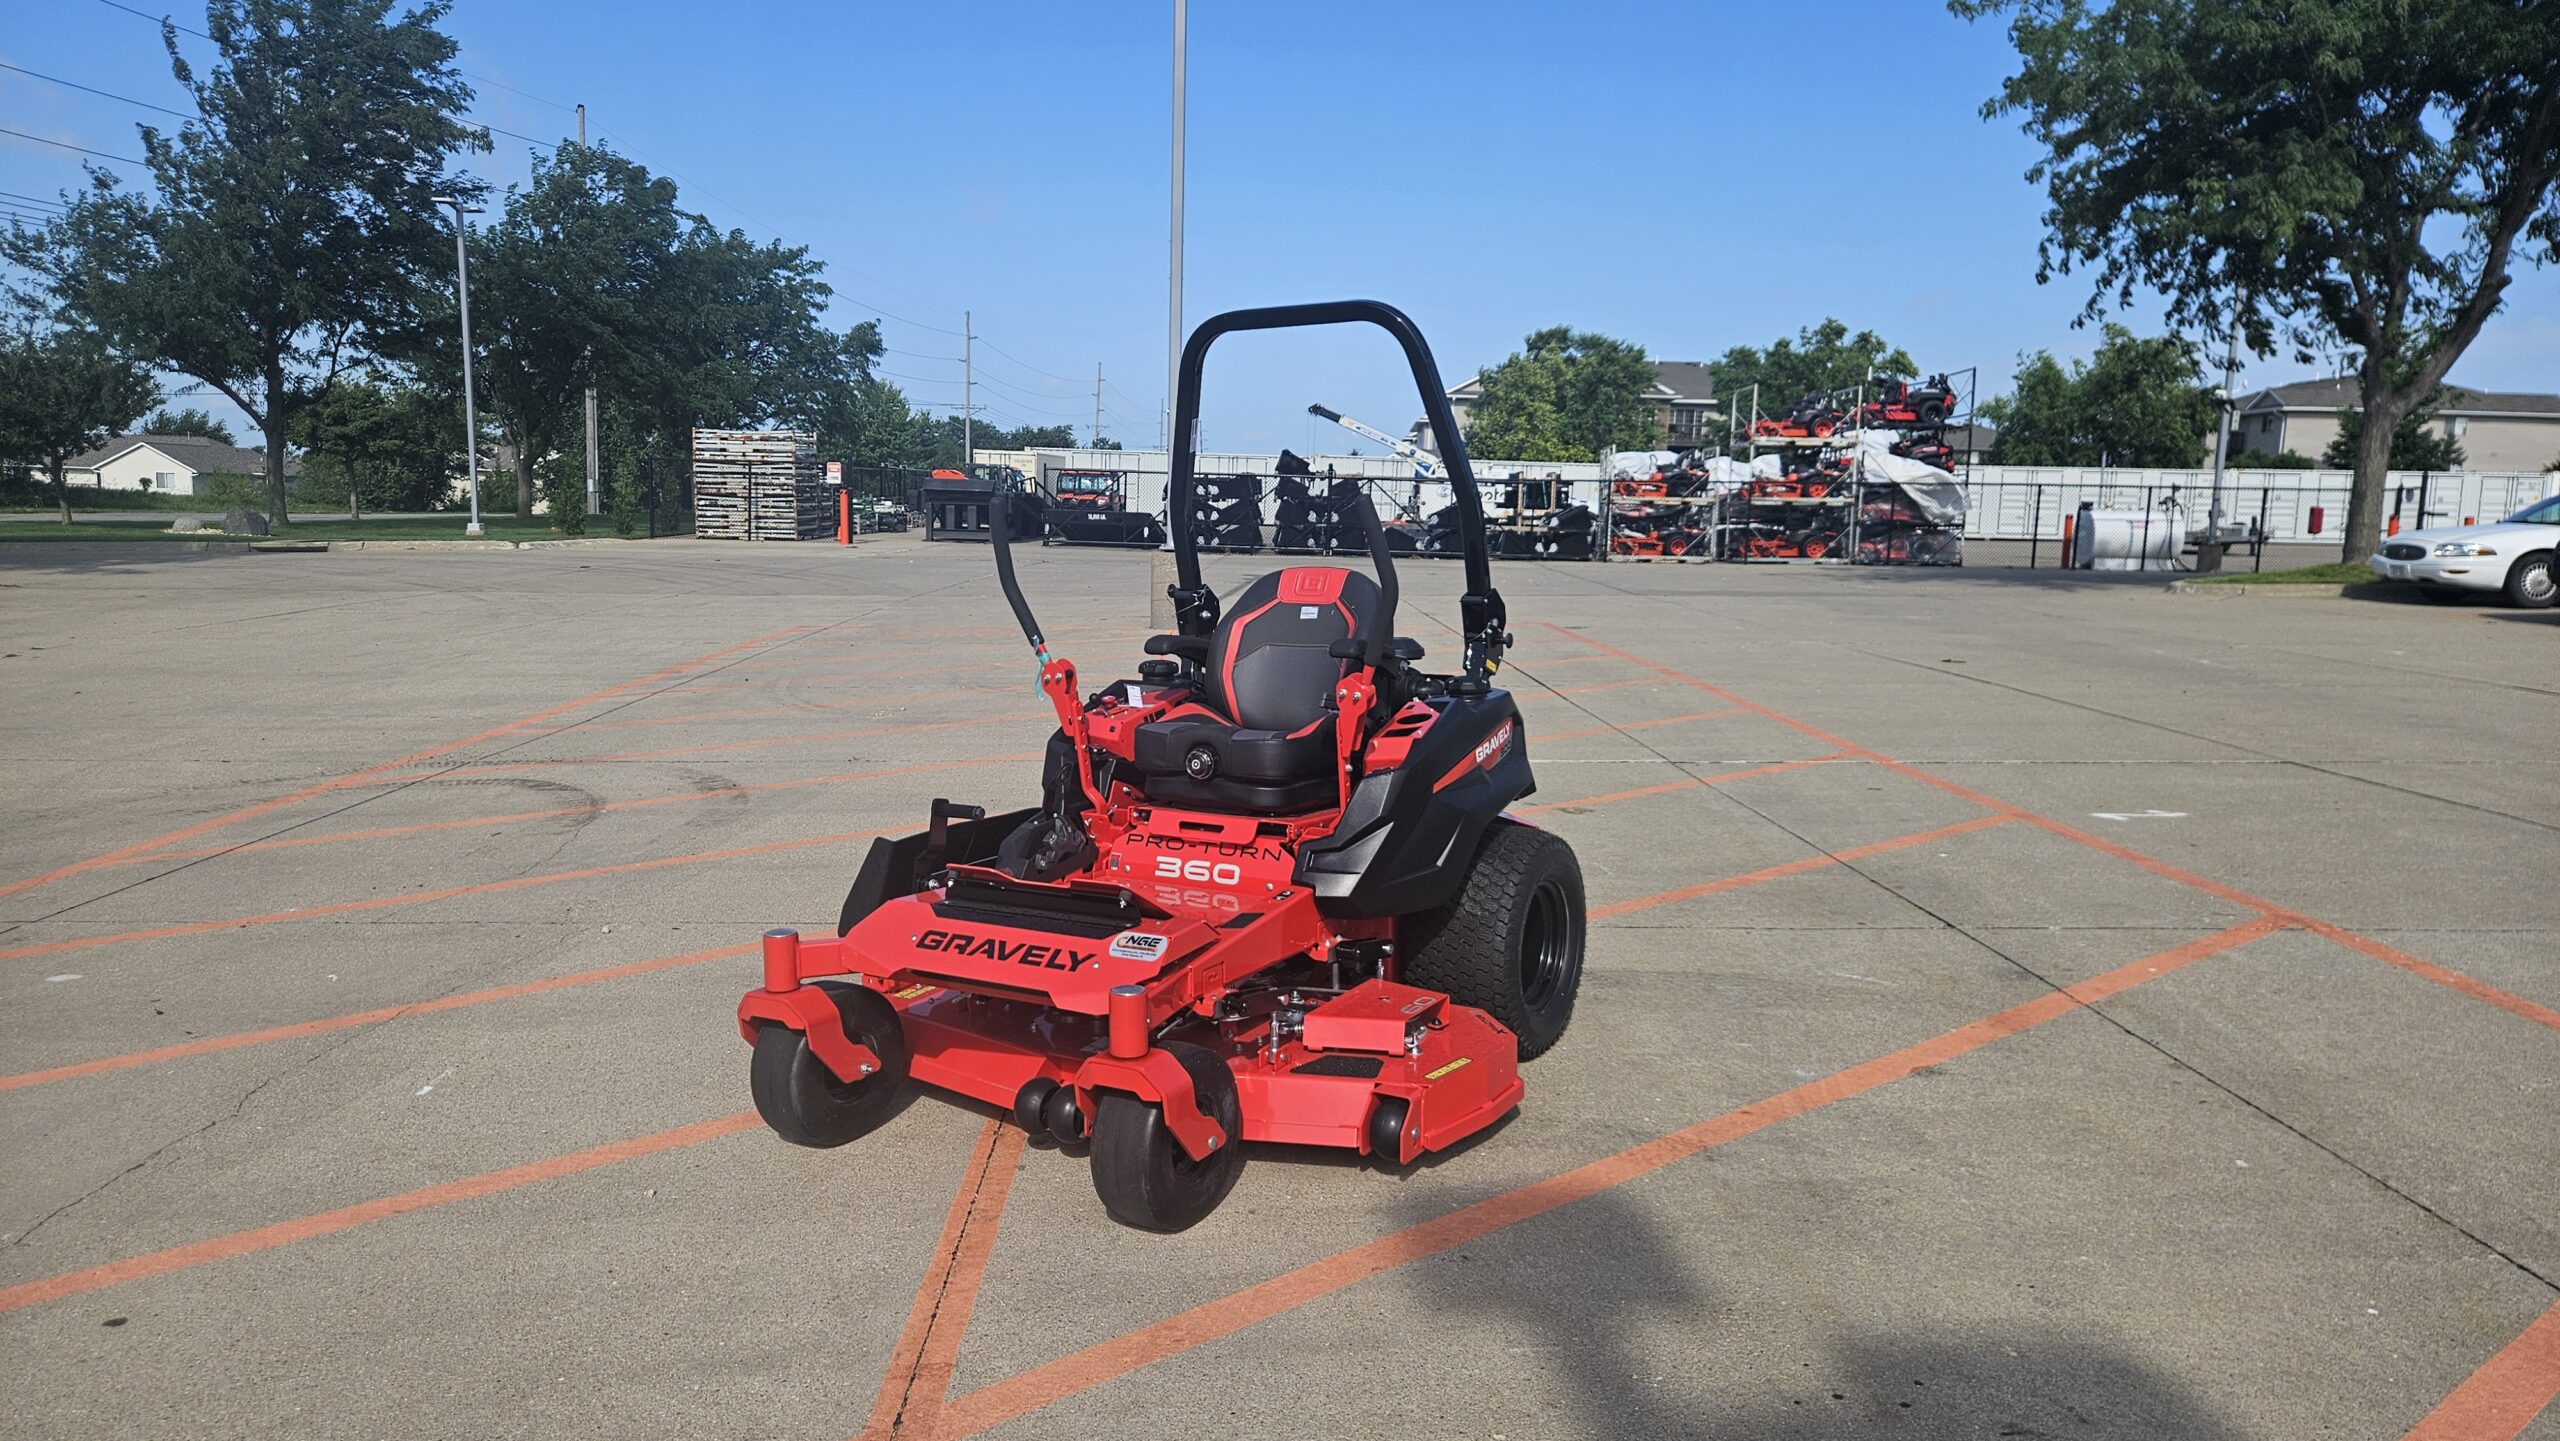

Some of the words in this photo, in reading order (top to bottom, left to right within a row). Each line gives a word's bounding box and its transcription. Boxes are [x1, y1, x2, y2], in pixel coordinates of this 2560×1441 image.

[1475, 721, 1511, 763] GRAVELY
[1126, 833, 1282, 861] PRO-TURN
[1154, 855, 1241, 886] 360
[915, 930, 1097, 972] GRAVELY
